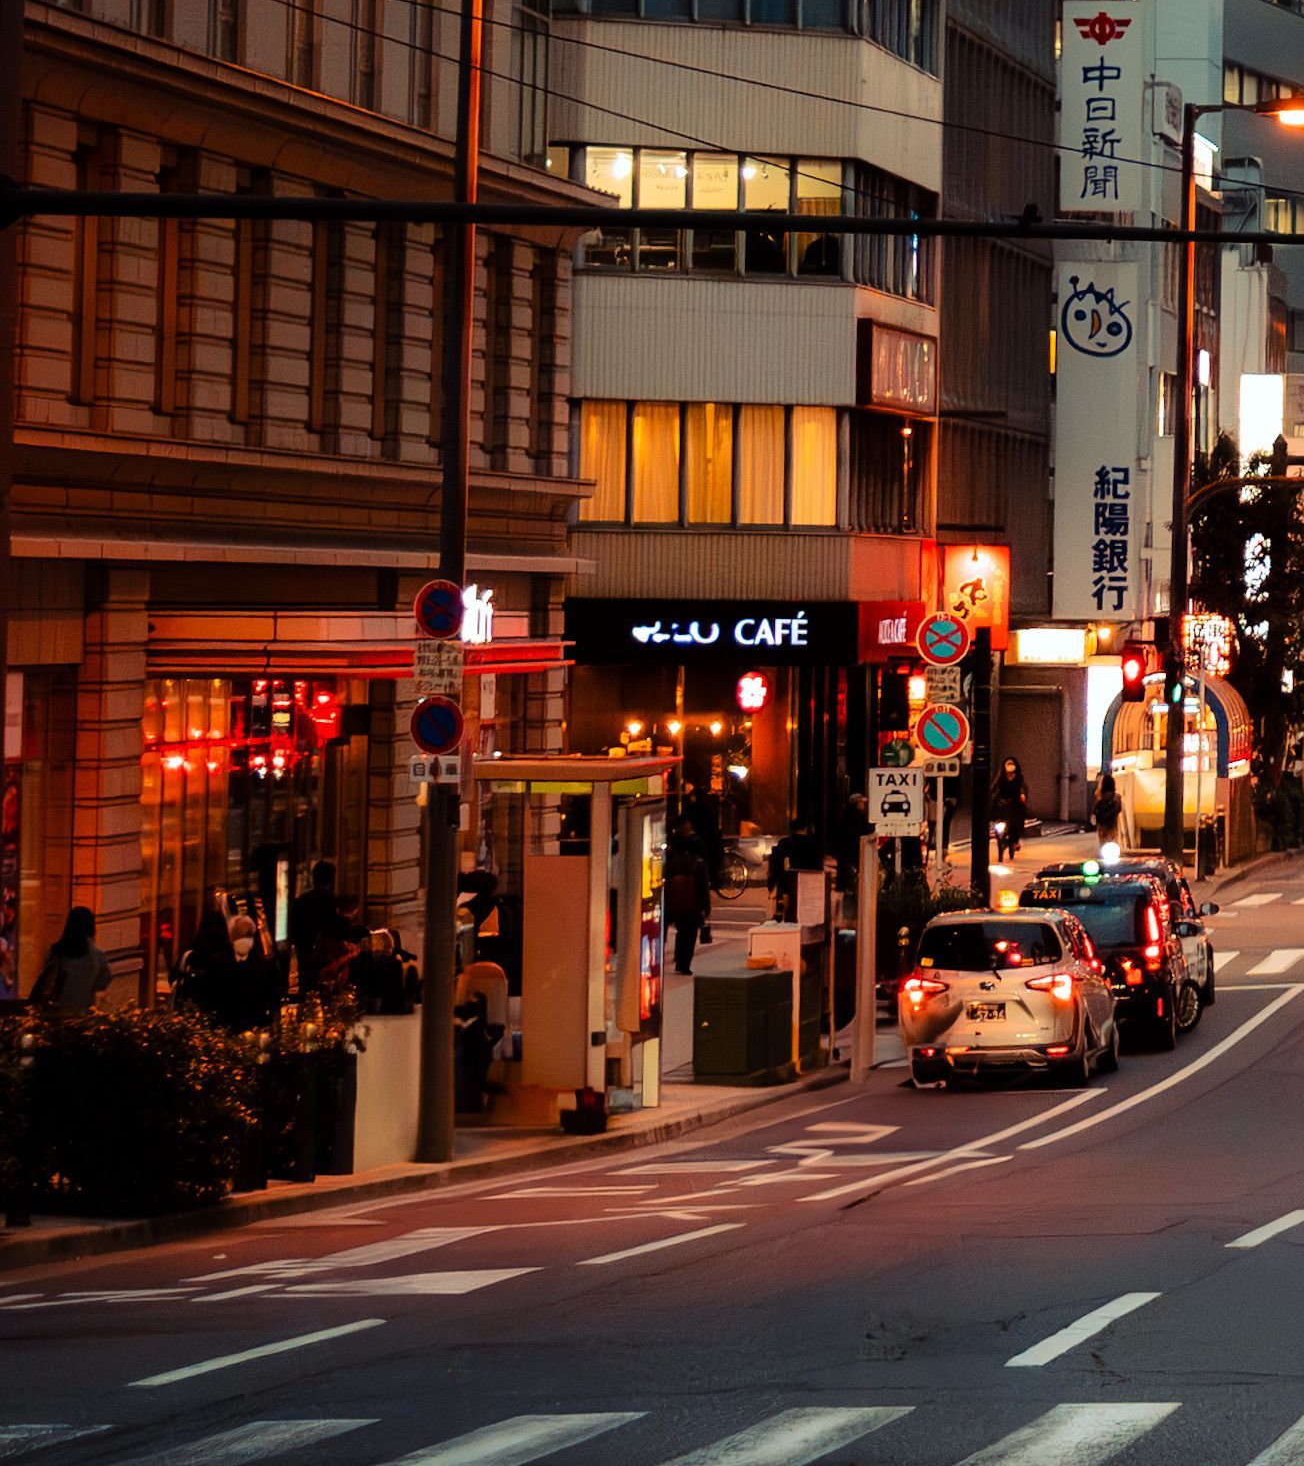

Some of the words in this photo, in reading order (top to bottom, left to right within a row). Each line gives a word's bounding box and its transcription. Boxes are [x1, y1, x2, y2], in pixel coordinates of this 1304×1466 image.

[1080, 55, 1121, 200] 中日新聞
[1091, 465, 1131, 611] 紀陽銀行
[734, 611, 808, 646] CAFÉ
[876, 773, 917, 787] TAXI
